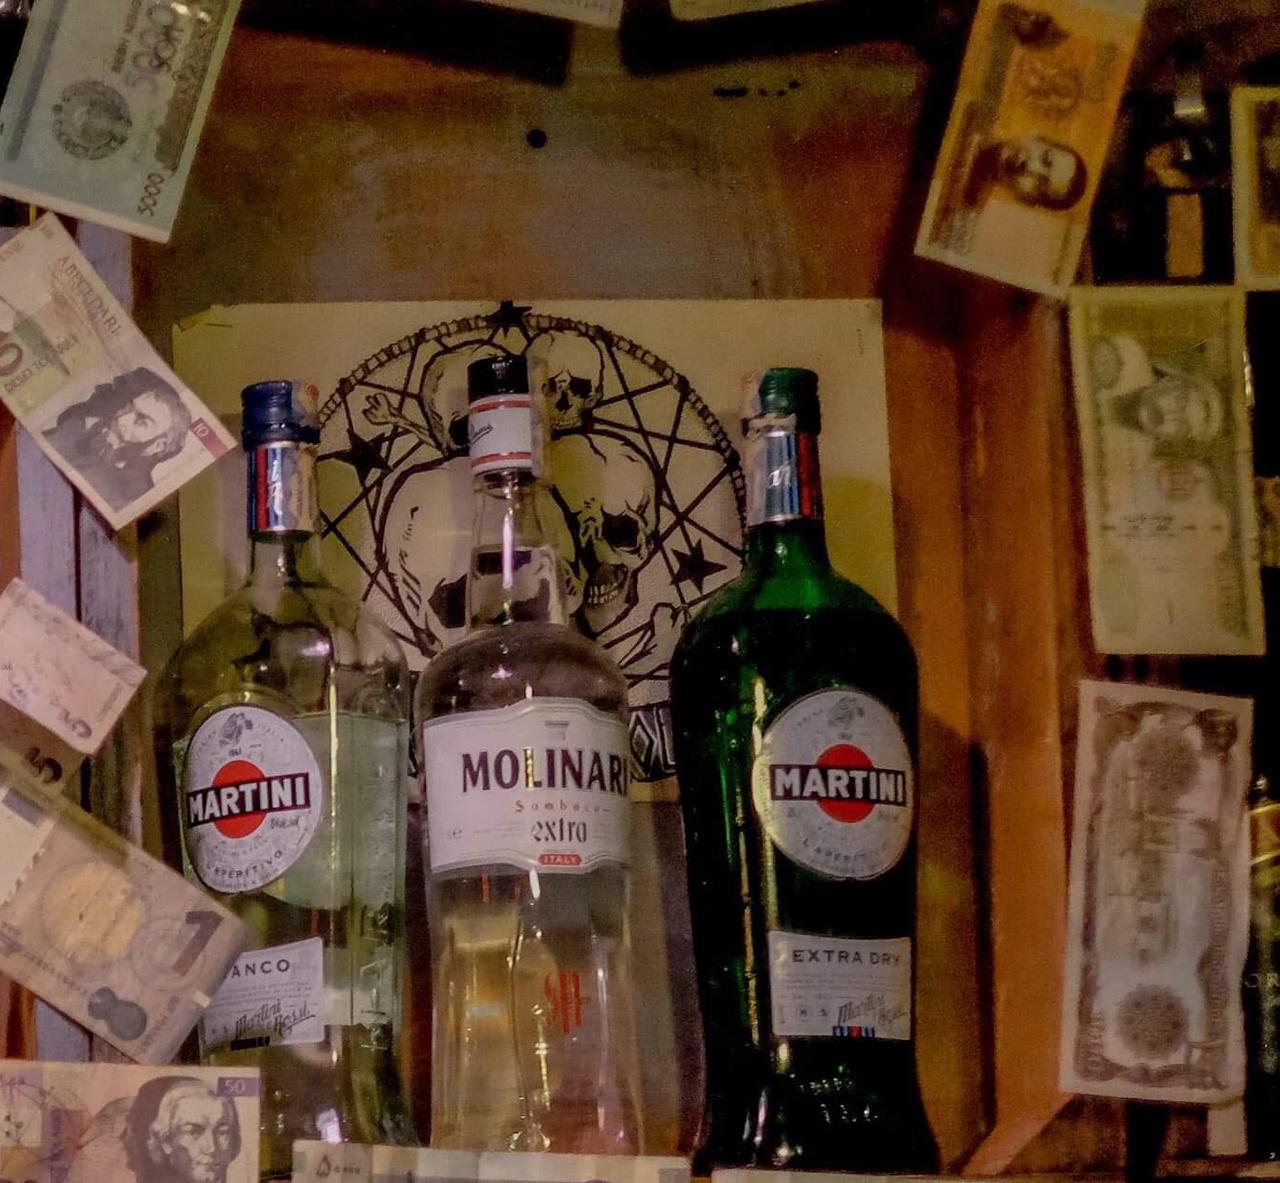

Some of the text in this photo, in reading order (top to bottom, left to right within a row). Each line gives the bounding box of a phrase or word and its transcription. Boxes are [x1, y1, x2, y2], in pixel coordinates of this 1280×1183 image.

[461, 747, 628, 797] MOLINARI
[774, 768, 905, 803] MARTINI
[190, 776, 307, 824] MARTINI
[530, 816, 588, 843] extra
[173, 909, 226, 977] 1
[792, 949, 863, 964] EXTRA
[231, 958, 291, 979] ANCO
[224, 1078, 247, 1095] 50
